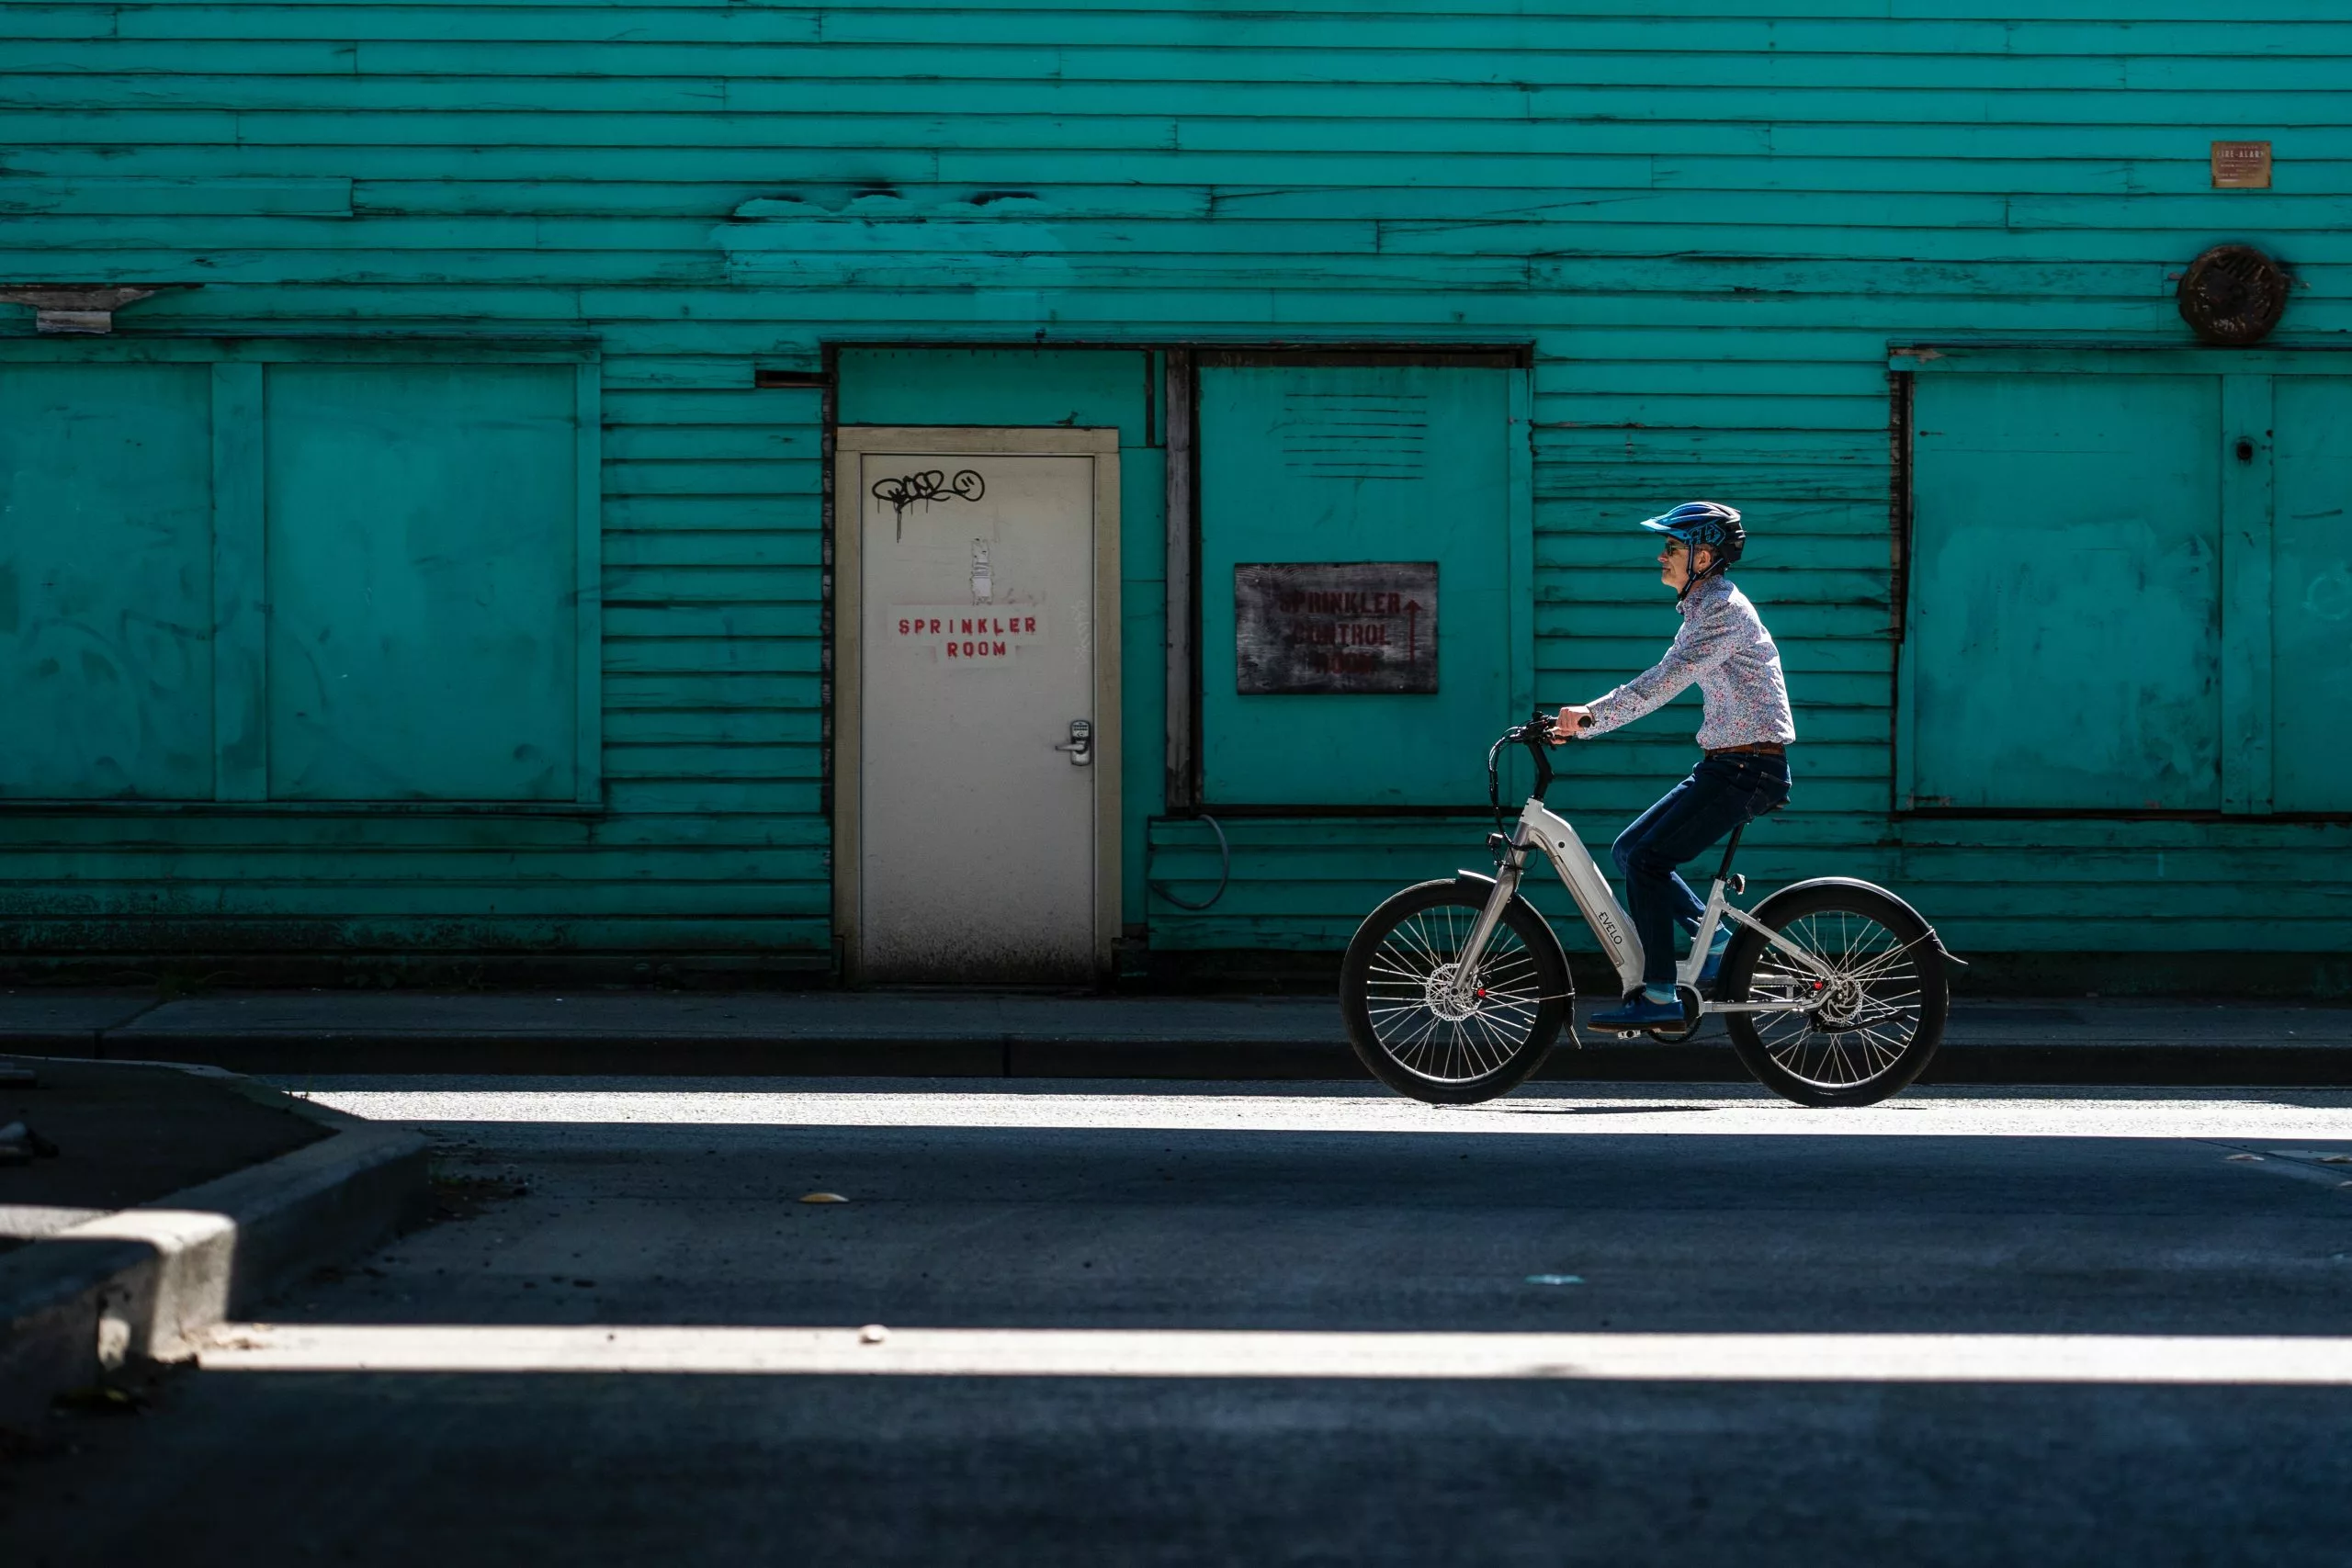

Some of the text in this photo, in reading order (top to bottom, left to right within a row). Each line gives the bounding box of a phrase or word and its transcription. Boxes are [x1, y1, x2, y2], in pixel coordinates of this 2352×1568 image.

[1279, 593, 1400, 614] SPRINKLER
[899, 617, 1036, 636] SPRINKLER
[1293, 624, 1391, 646] CONTROL
[947, 641, 1007, 658] ROOM
[1599, 911, 1623, 944] EVELO
